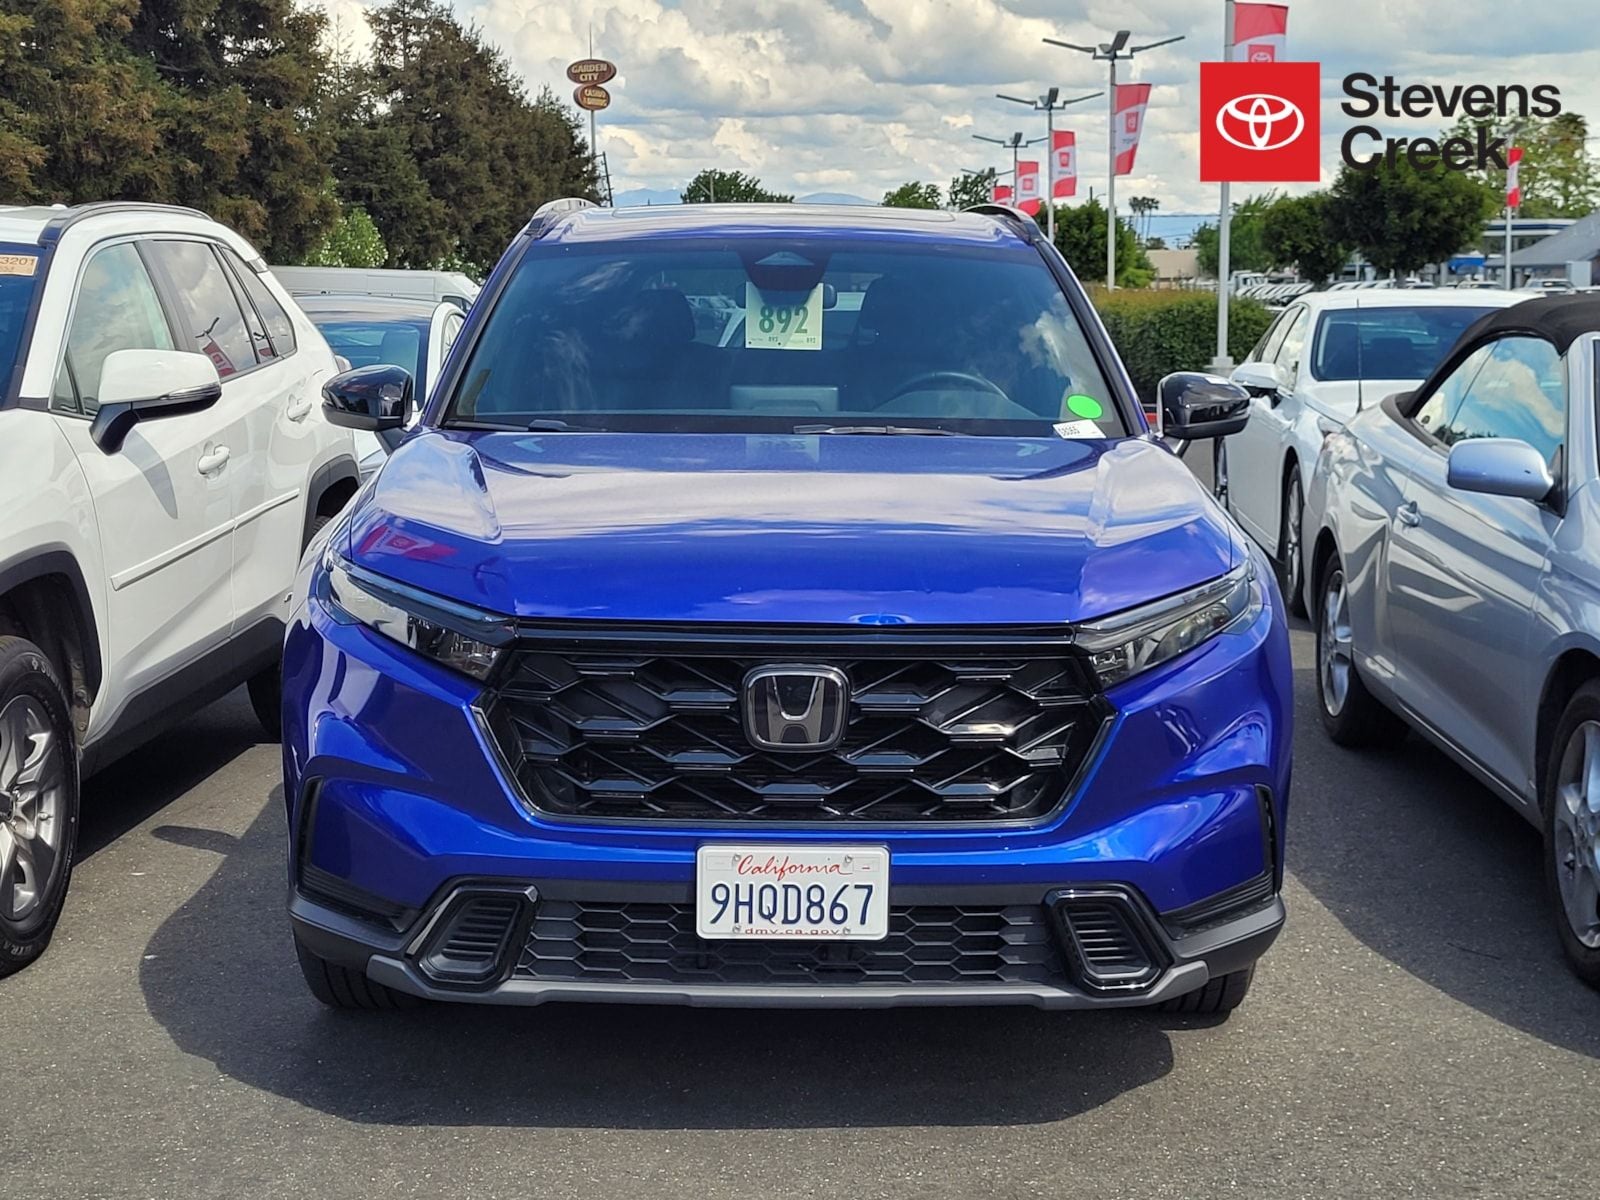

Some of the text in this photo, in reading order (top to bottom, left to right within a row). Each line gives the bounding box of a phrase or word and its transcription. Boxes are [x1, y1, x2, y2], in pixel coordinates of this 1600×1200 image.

[571, 63, 608, 74] GARDEN
[579, 73, 599, 81] CITY
[0, 256, 34, 266] 3201
[759, 305, 809, 334] 892
[737, 854, 853, 881] California
[709, 883, 874, 926] 9HQD867
[744, 927, 840, 936] dmv.ca.gov
